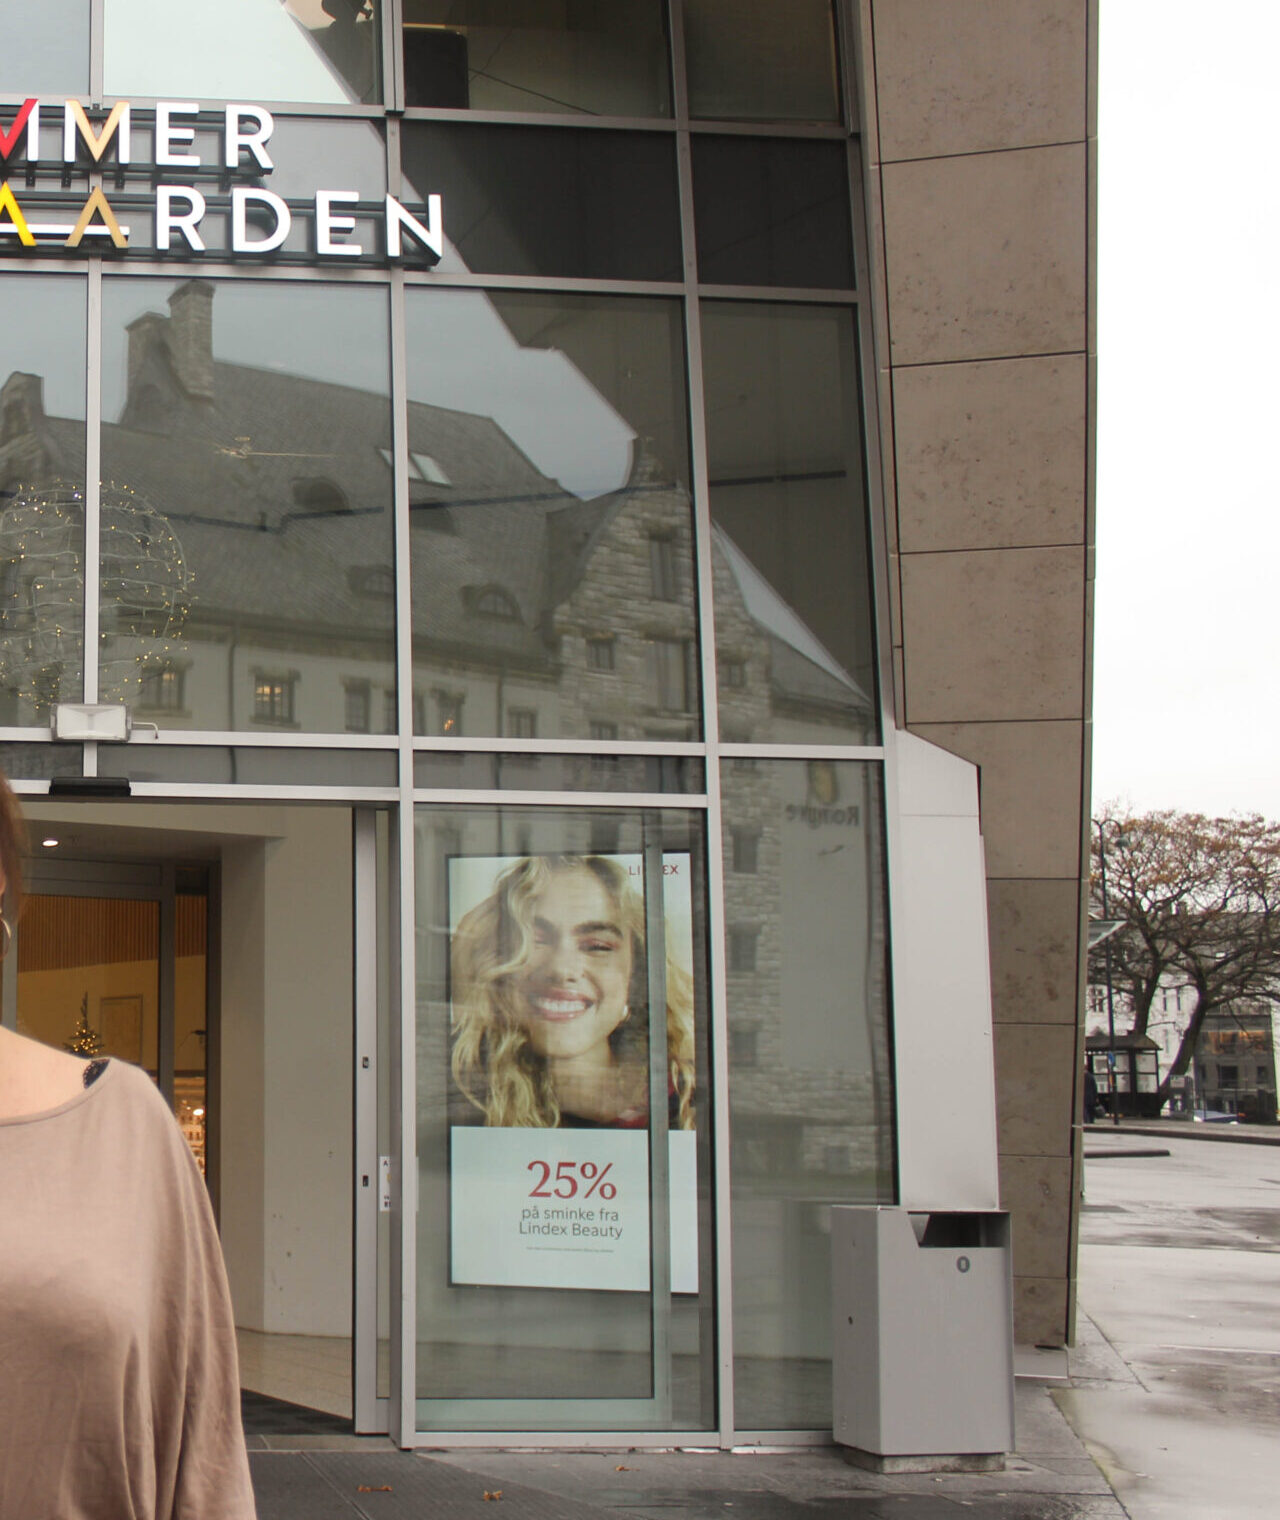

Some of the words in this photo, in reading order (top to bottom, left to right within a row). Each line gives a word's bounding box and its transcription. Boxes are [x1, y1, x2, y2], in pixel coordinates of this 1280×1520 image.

[628, 864, 679, 876] LIEX
[526, 1159, 618, 1200] 25%
[521, 1205, 540, 1222] på
[543, 1207, 595, 1221] sminke
[599, 1207, 619, 1222] fra
[519, 1221, 568, 1236] Lindex
[571, 1223, 624, 1240] Beauty
